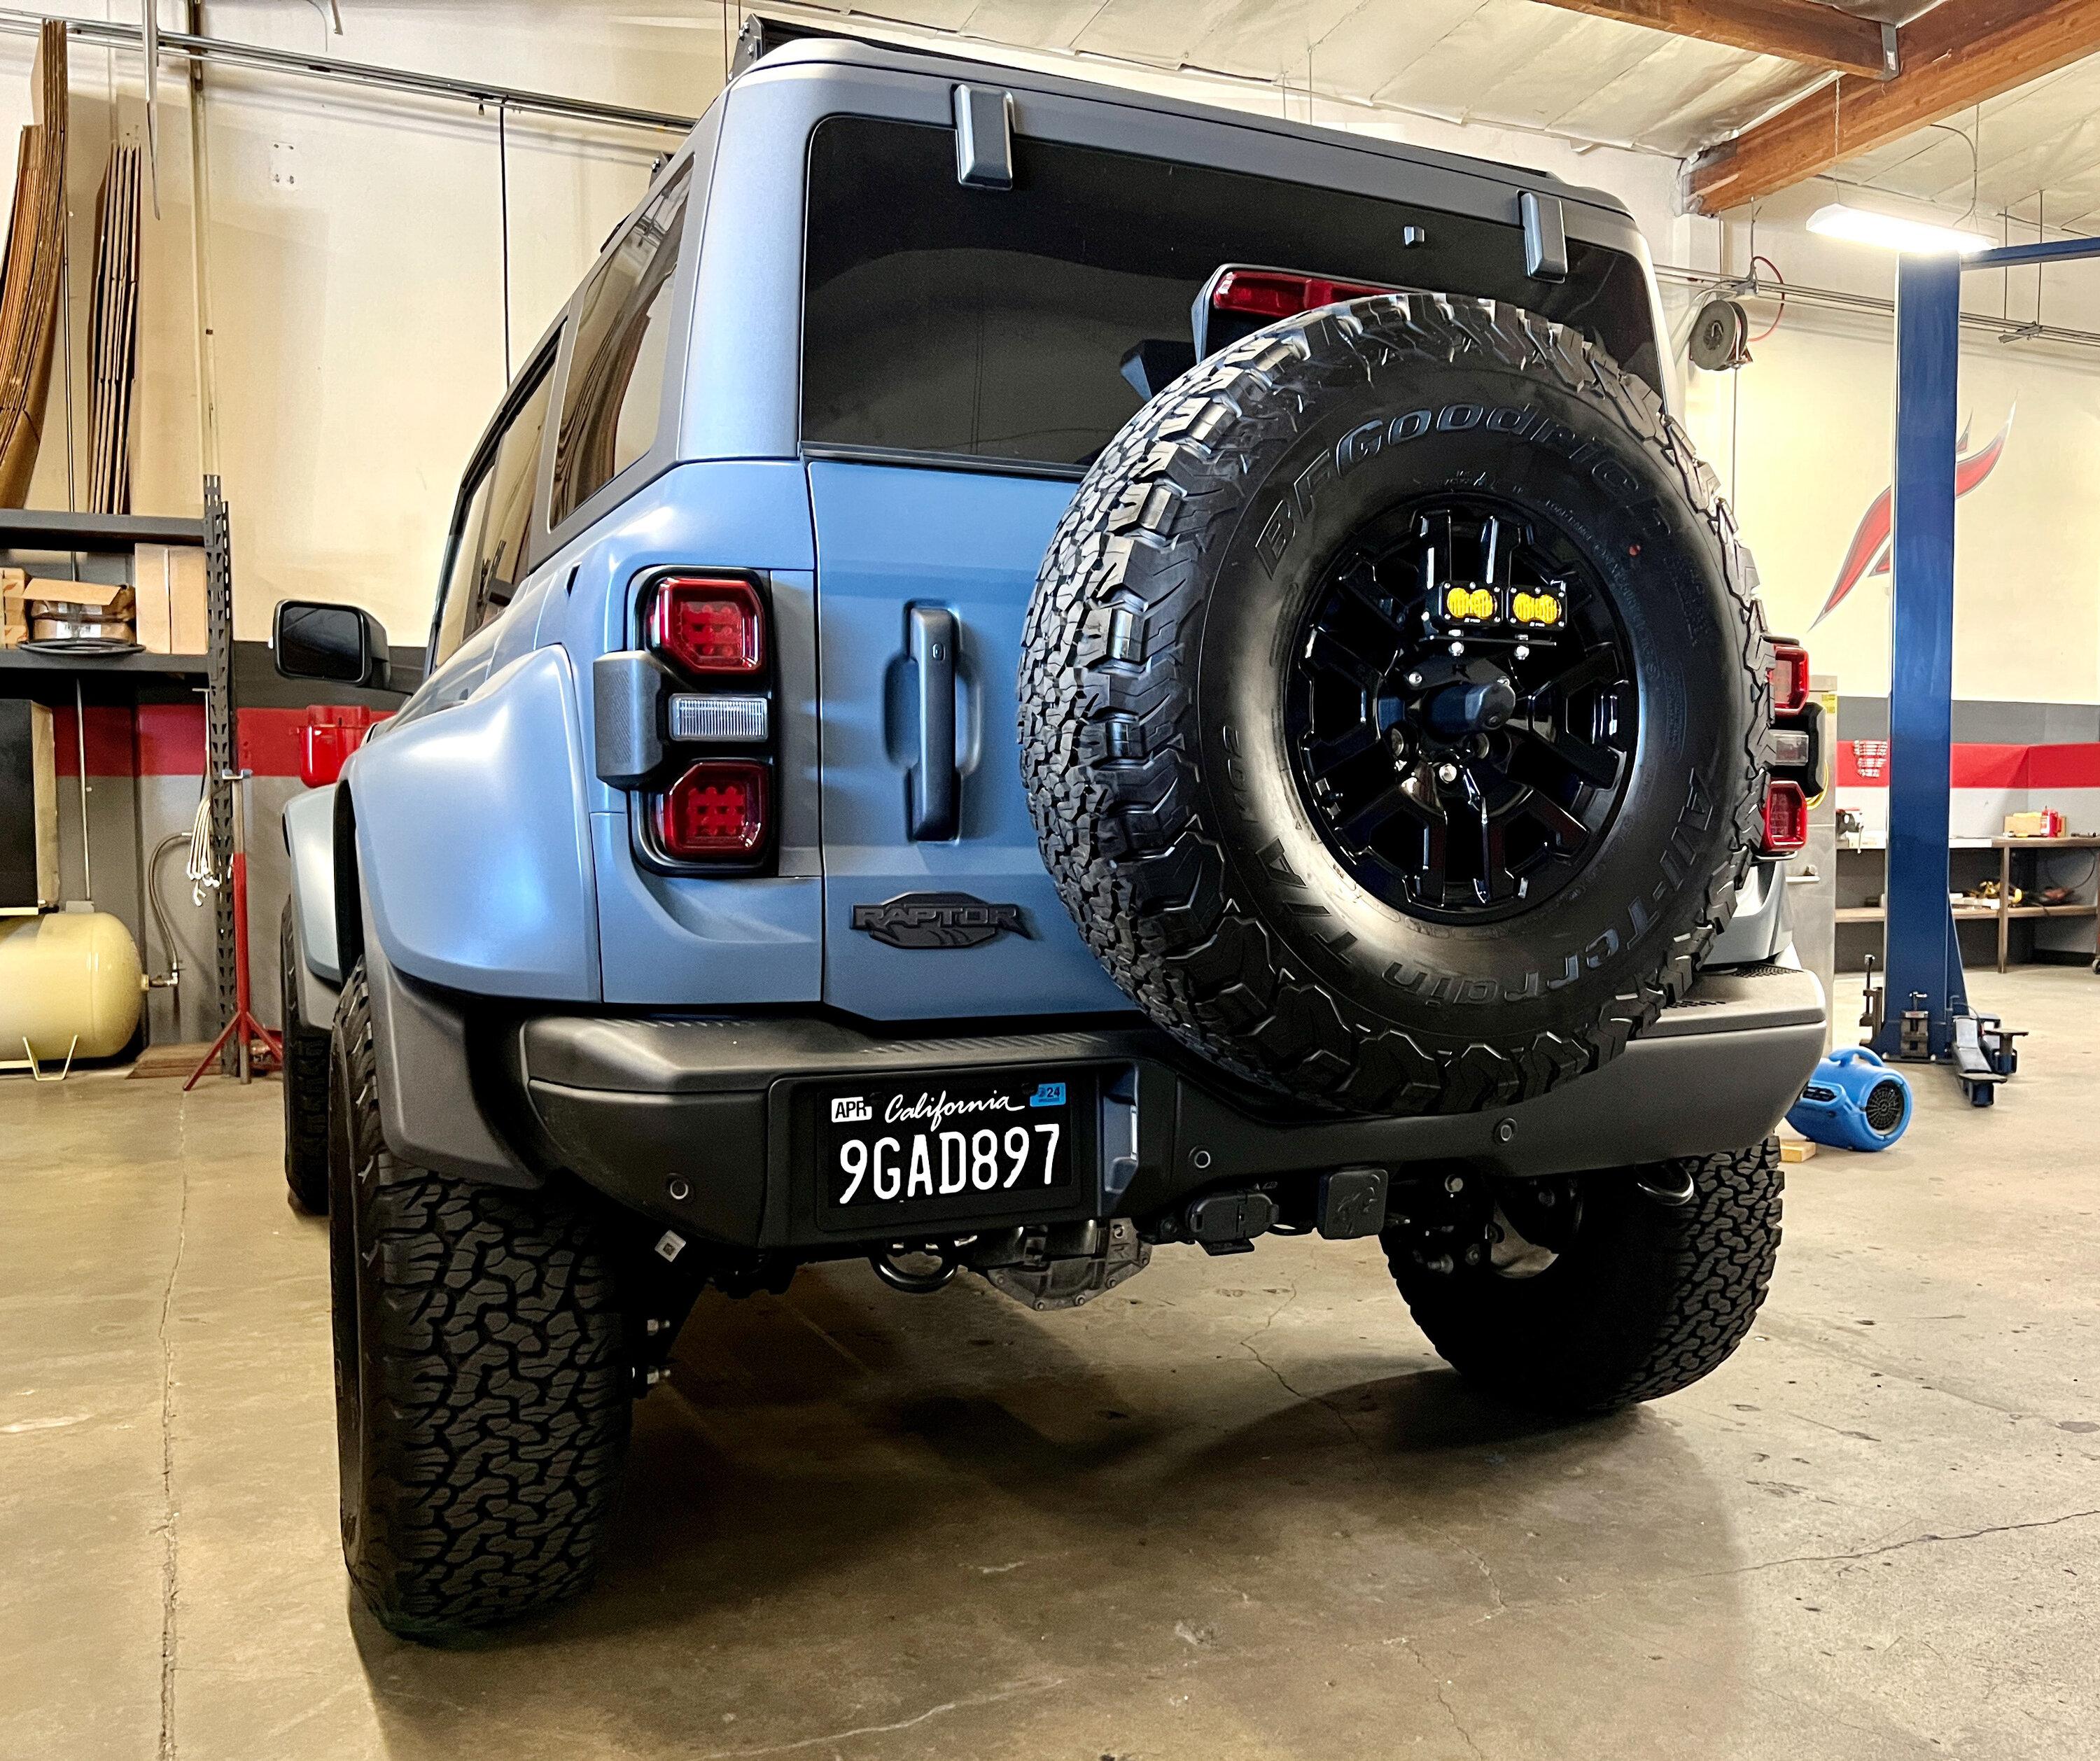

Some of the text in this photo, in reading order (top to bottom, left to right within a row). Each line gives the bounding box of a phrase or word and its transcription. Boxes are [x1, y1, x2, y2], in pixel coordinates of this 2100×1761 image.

[853, 903, 1032, 941] RAPTOR
[1255, 834, 1359, 967] T/A
[835, 1100, 867, 1119] APR
[885, 1090, 1026, 1132] California
[839, 1123, 1060, 1205] 9GAD897
